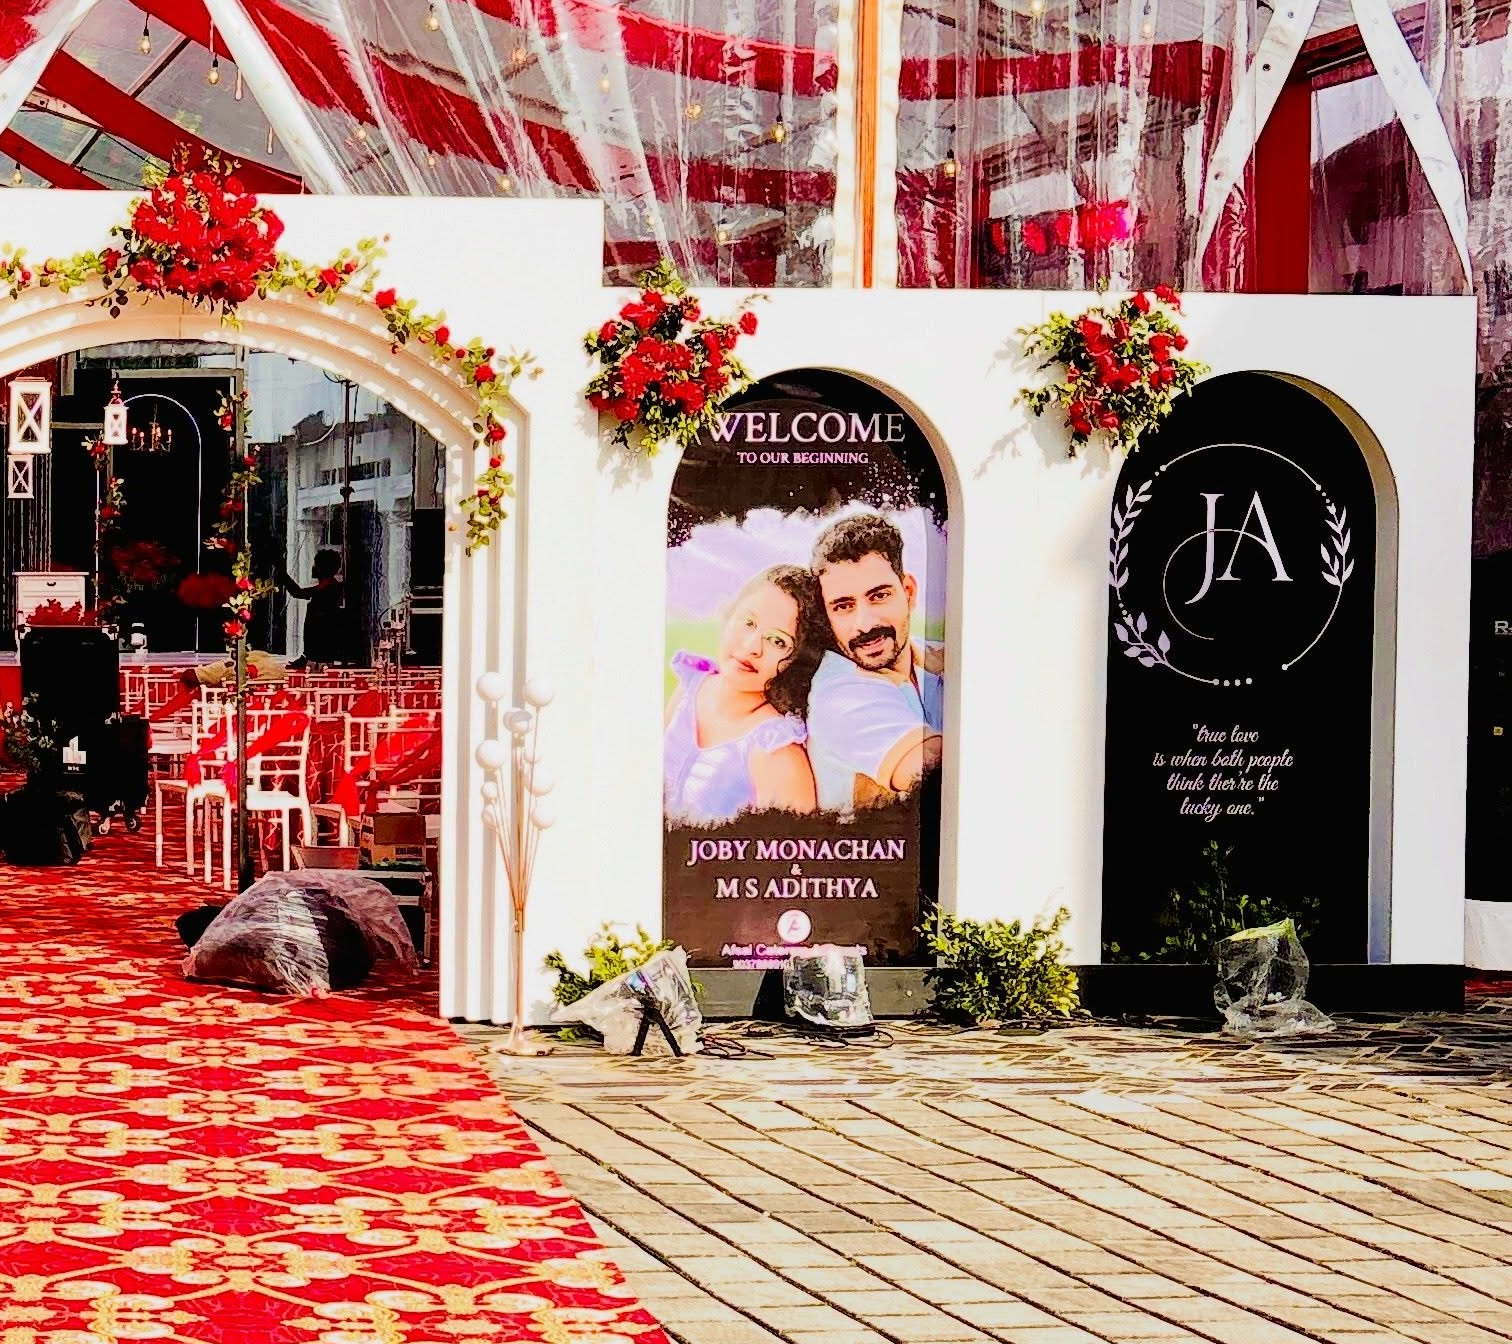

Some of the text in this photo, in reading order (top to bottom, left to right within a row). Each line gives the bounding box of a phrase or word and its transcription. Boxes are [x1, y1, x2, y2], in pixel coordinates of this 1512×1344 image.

[709, 412, 906, 443] WELCOME
[737, 451, 869, 464] TO OUR BEGINNING
[1230, 724, 1260, 743] love
[1152, 748, 1294, 774] is when both people
[1166, 773, 1205, 791] think
[1257, 773, 1279, 791] the
[1180, 796, 1223, 823] lucky
[687, 839, 906, 866] JOBY MONACHAN
[791, 863, 803, 876] &
[715, 877, 879, 899] M S ADITHYA
